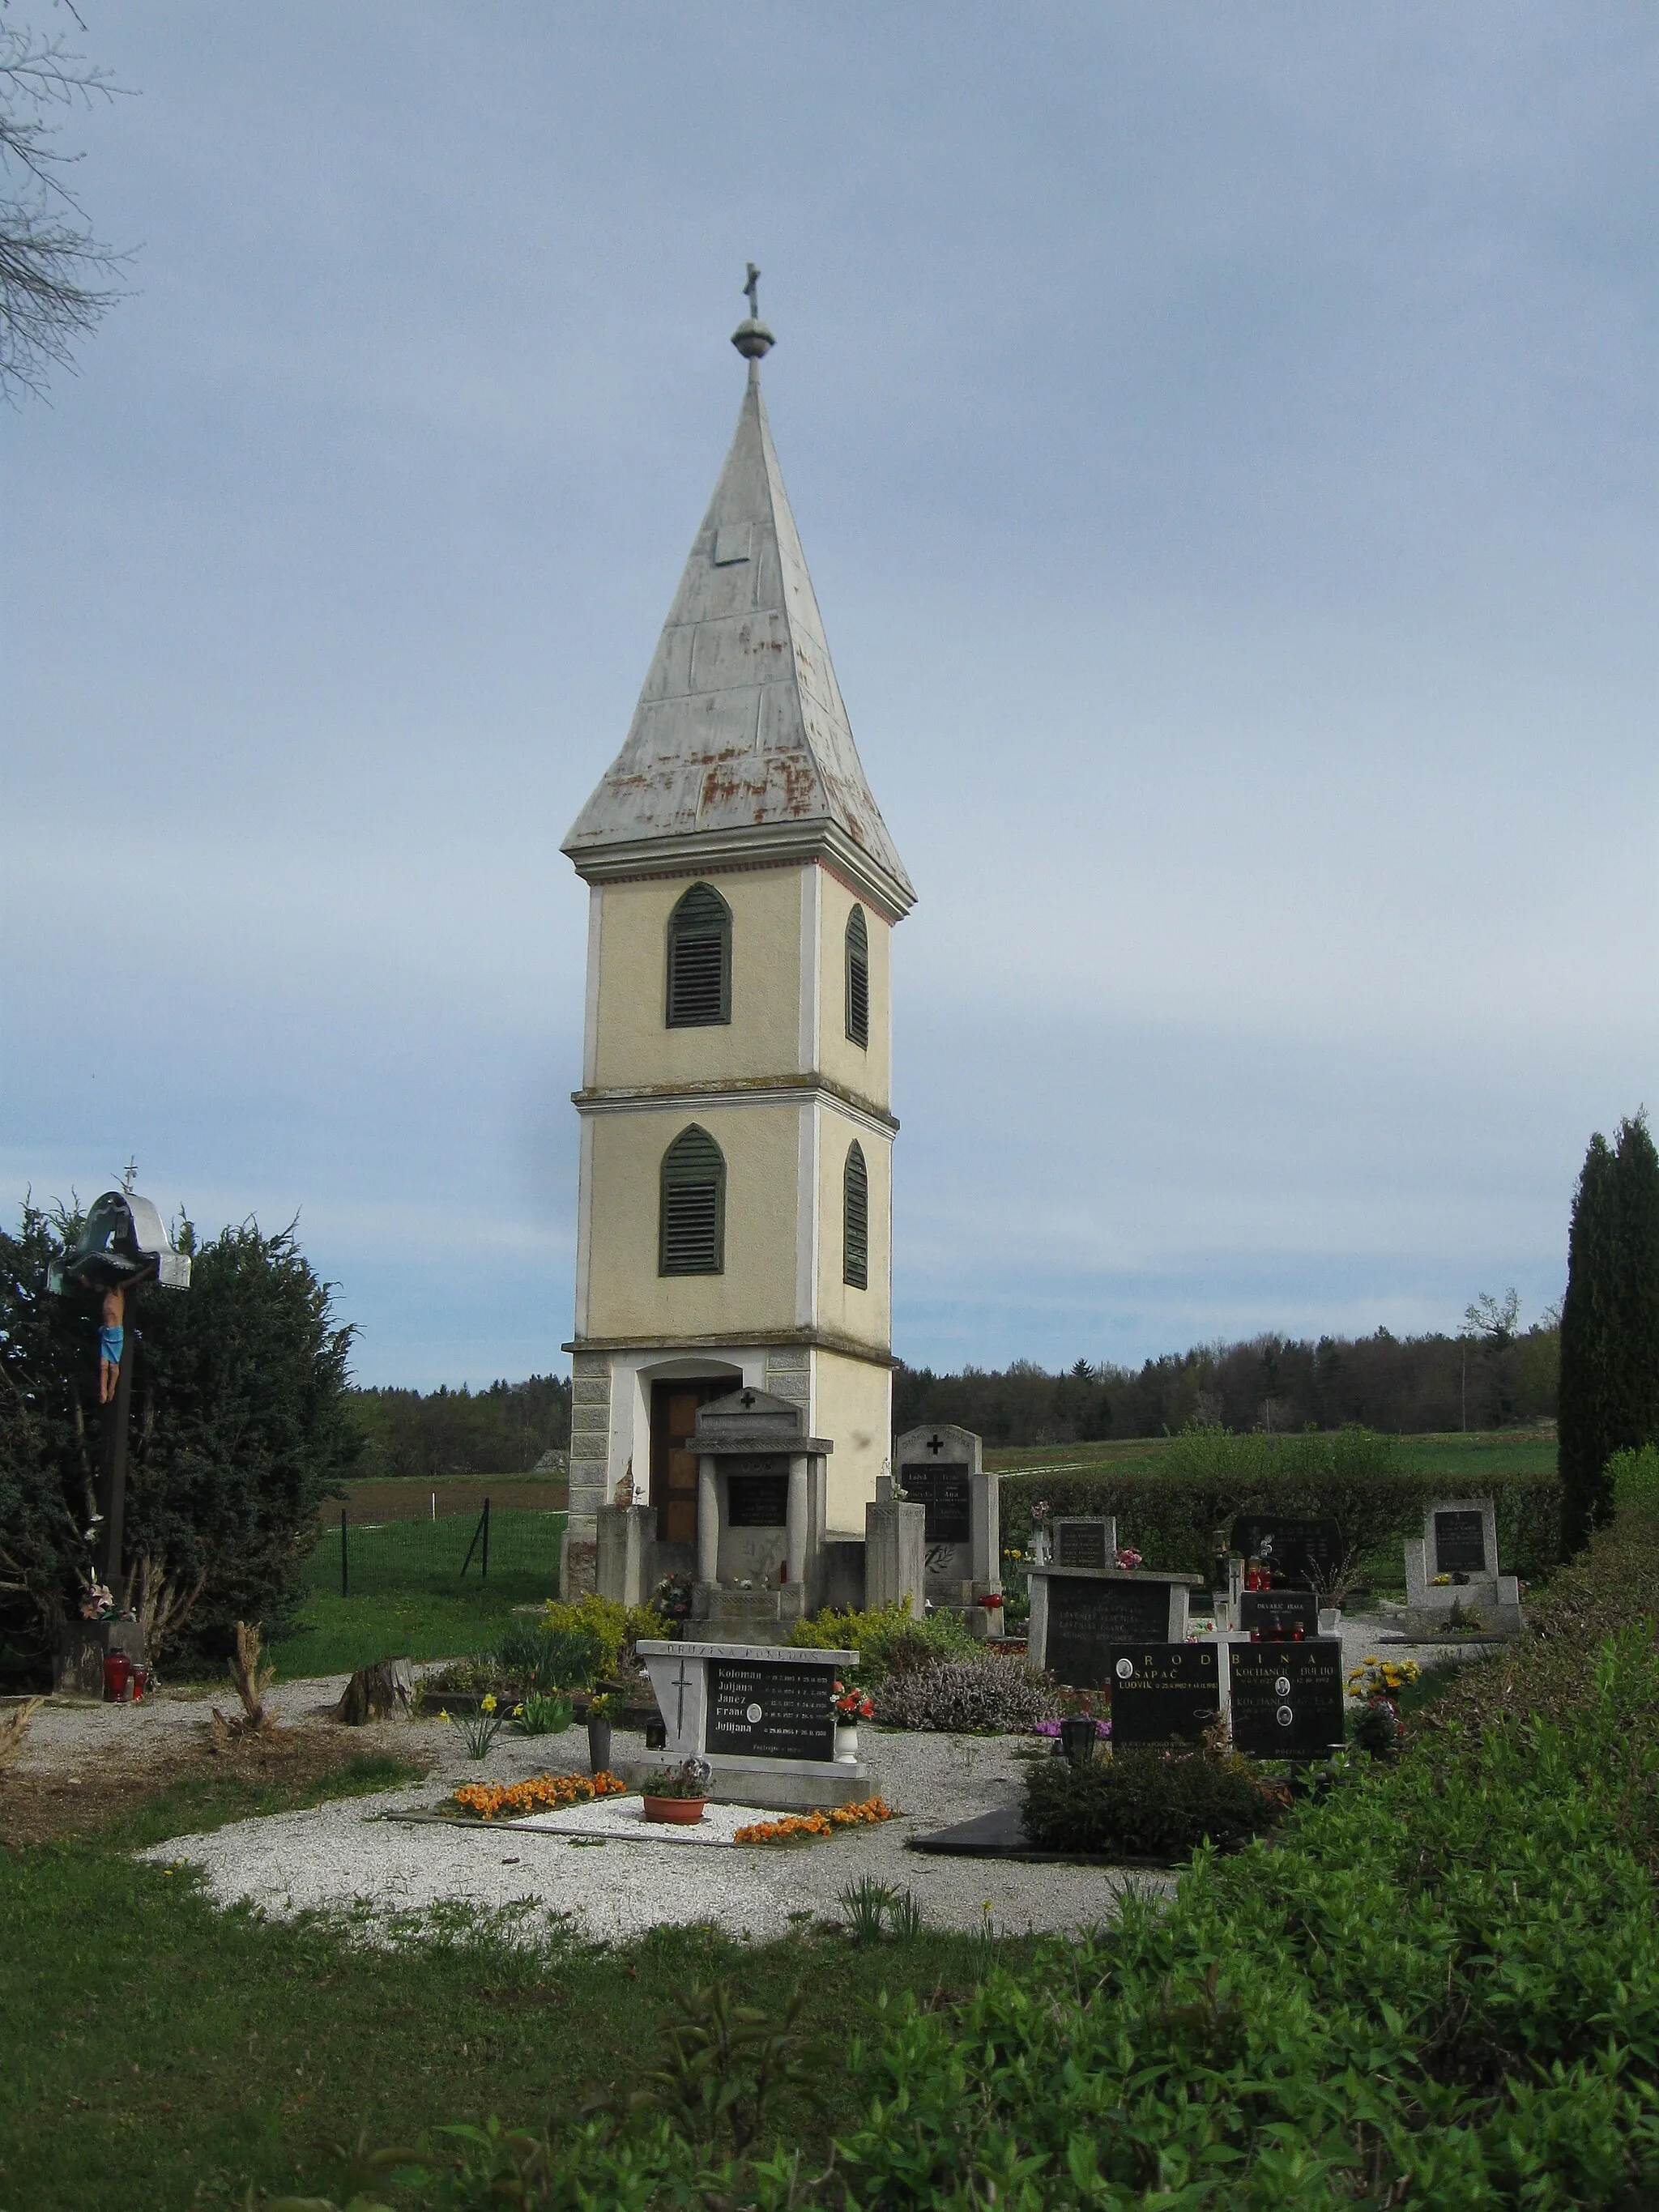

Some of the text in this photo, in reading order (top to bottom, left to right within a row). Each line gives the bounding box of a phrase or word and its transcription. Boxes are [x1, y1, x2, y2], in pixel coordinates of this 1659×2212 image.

[719, 1669, 761, 1680] Koloman
[1119, 1681, 1152, 1690] LUDVIK
[718, 1694, 746, 1704] Janez
